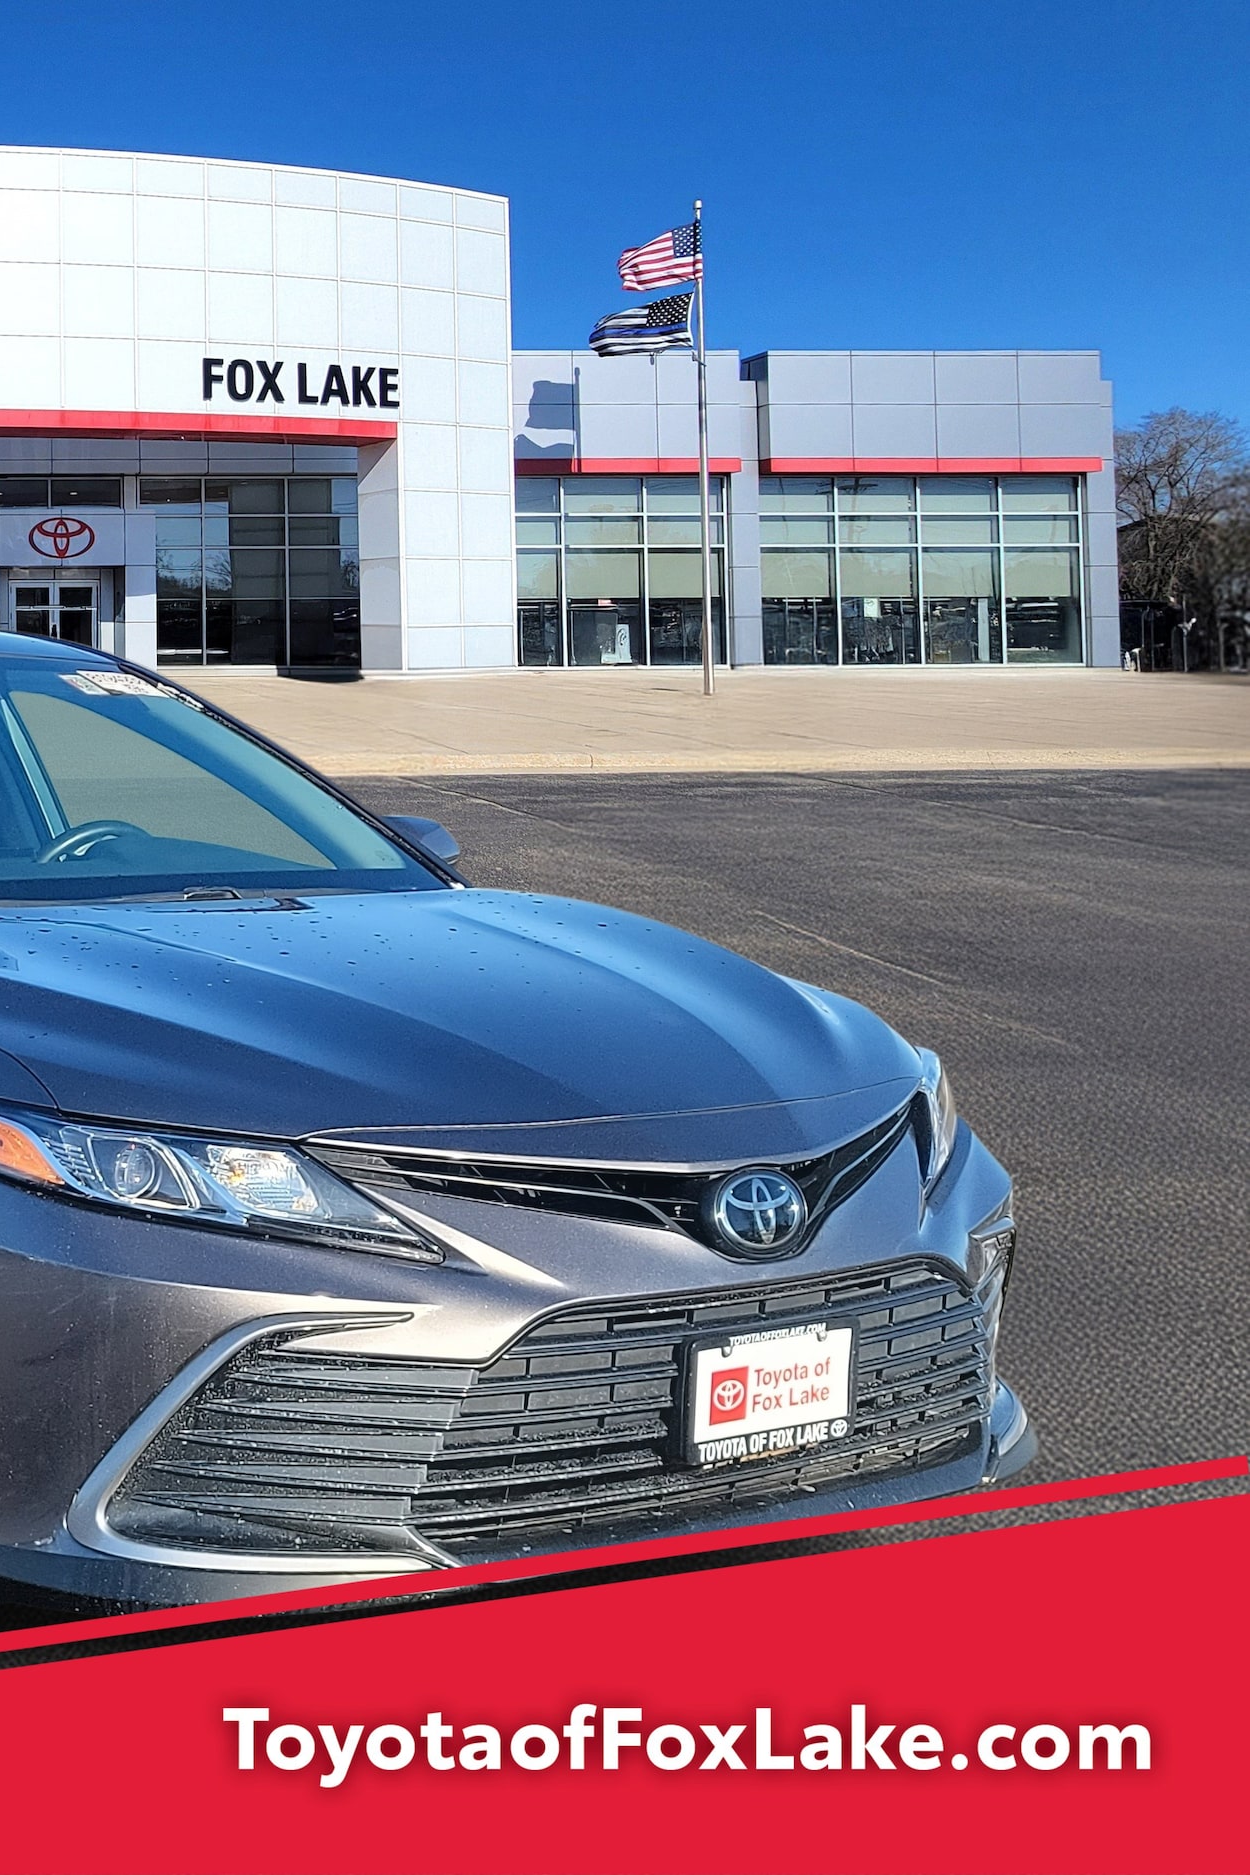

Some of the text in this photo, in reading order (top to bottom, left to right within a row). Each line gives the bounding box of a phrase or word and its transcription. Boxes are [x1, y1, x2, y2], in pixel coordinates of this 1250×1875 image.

[202, 357, 400, 408] FOX LAKE
[754, 1356, 831, 1389] Toyota of
[751, 1383, 830, 1413] Fox Lake
[698, 1420, 830, 1463] TOYOTA OF FOX LAKE
